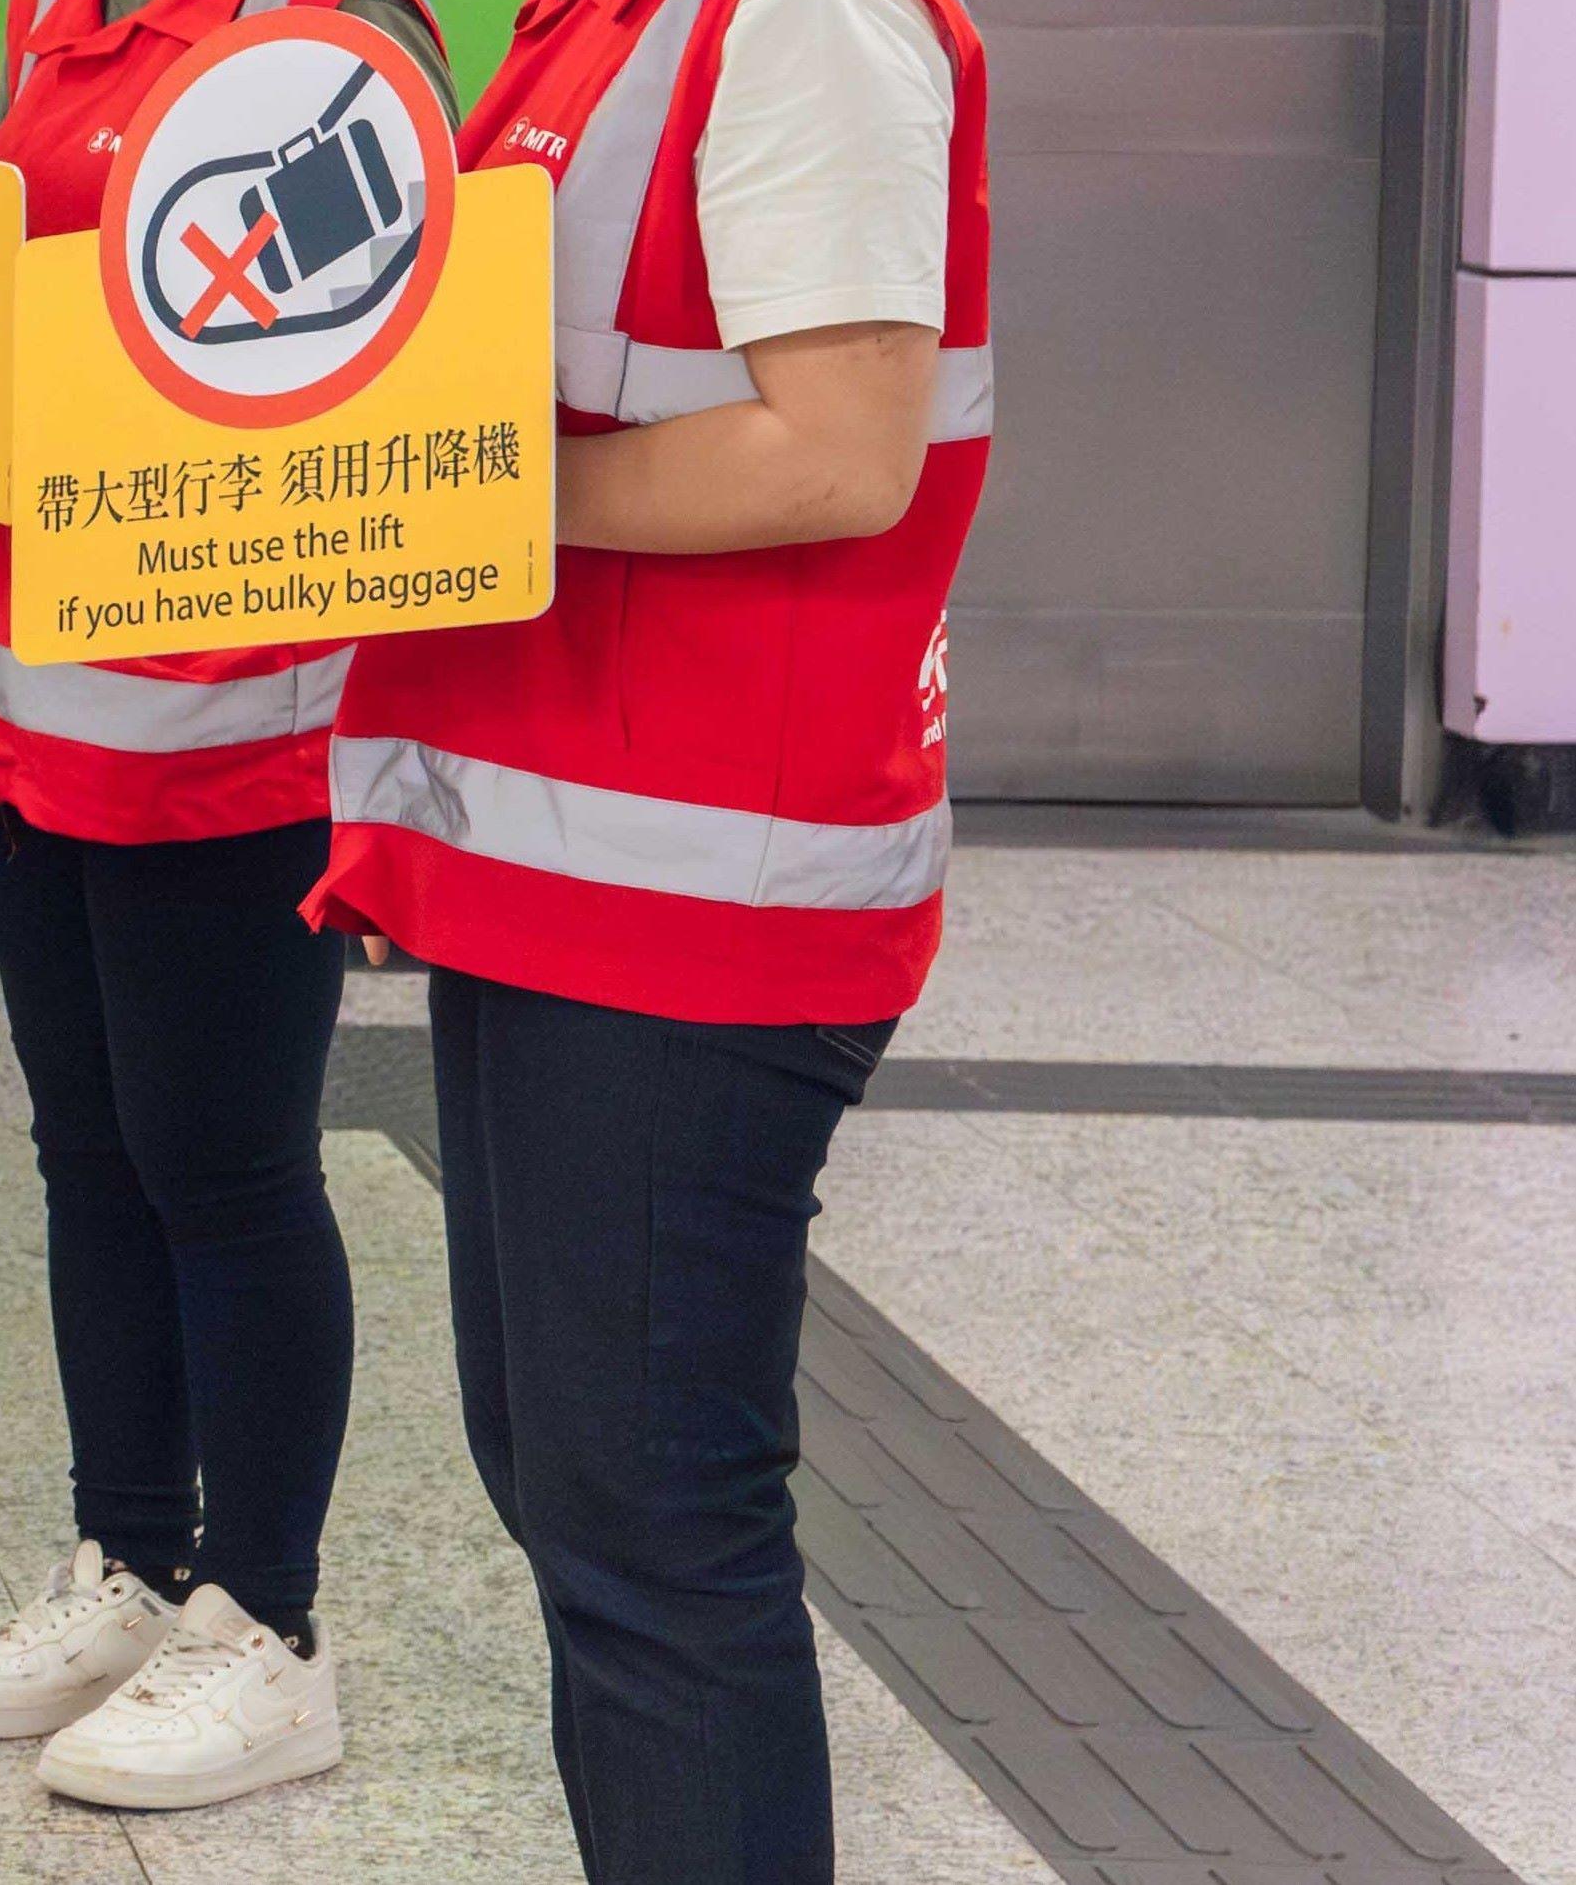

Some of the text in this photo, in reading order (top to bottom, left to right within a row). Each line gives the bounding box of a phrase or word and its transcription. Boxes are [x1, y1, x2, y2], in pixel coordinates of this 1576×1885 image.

[521, 126, 567, 161] MTR
[37, 421, 521, 533] 帶大型行李 須用升降機
[138, 513, 405, 576] Must use the lift
[58, 596, 80, 633] if
[86, 598, 144, 640] you
[156, 588, 233, 623] have
[244, 573, 335, 617] bulky
[345, 564, 499, 609] baggage
